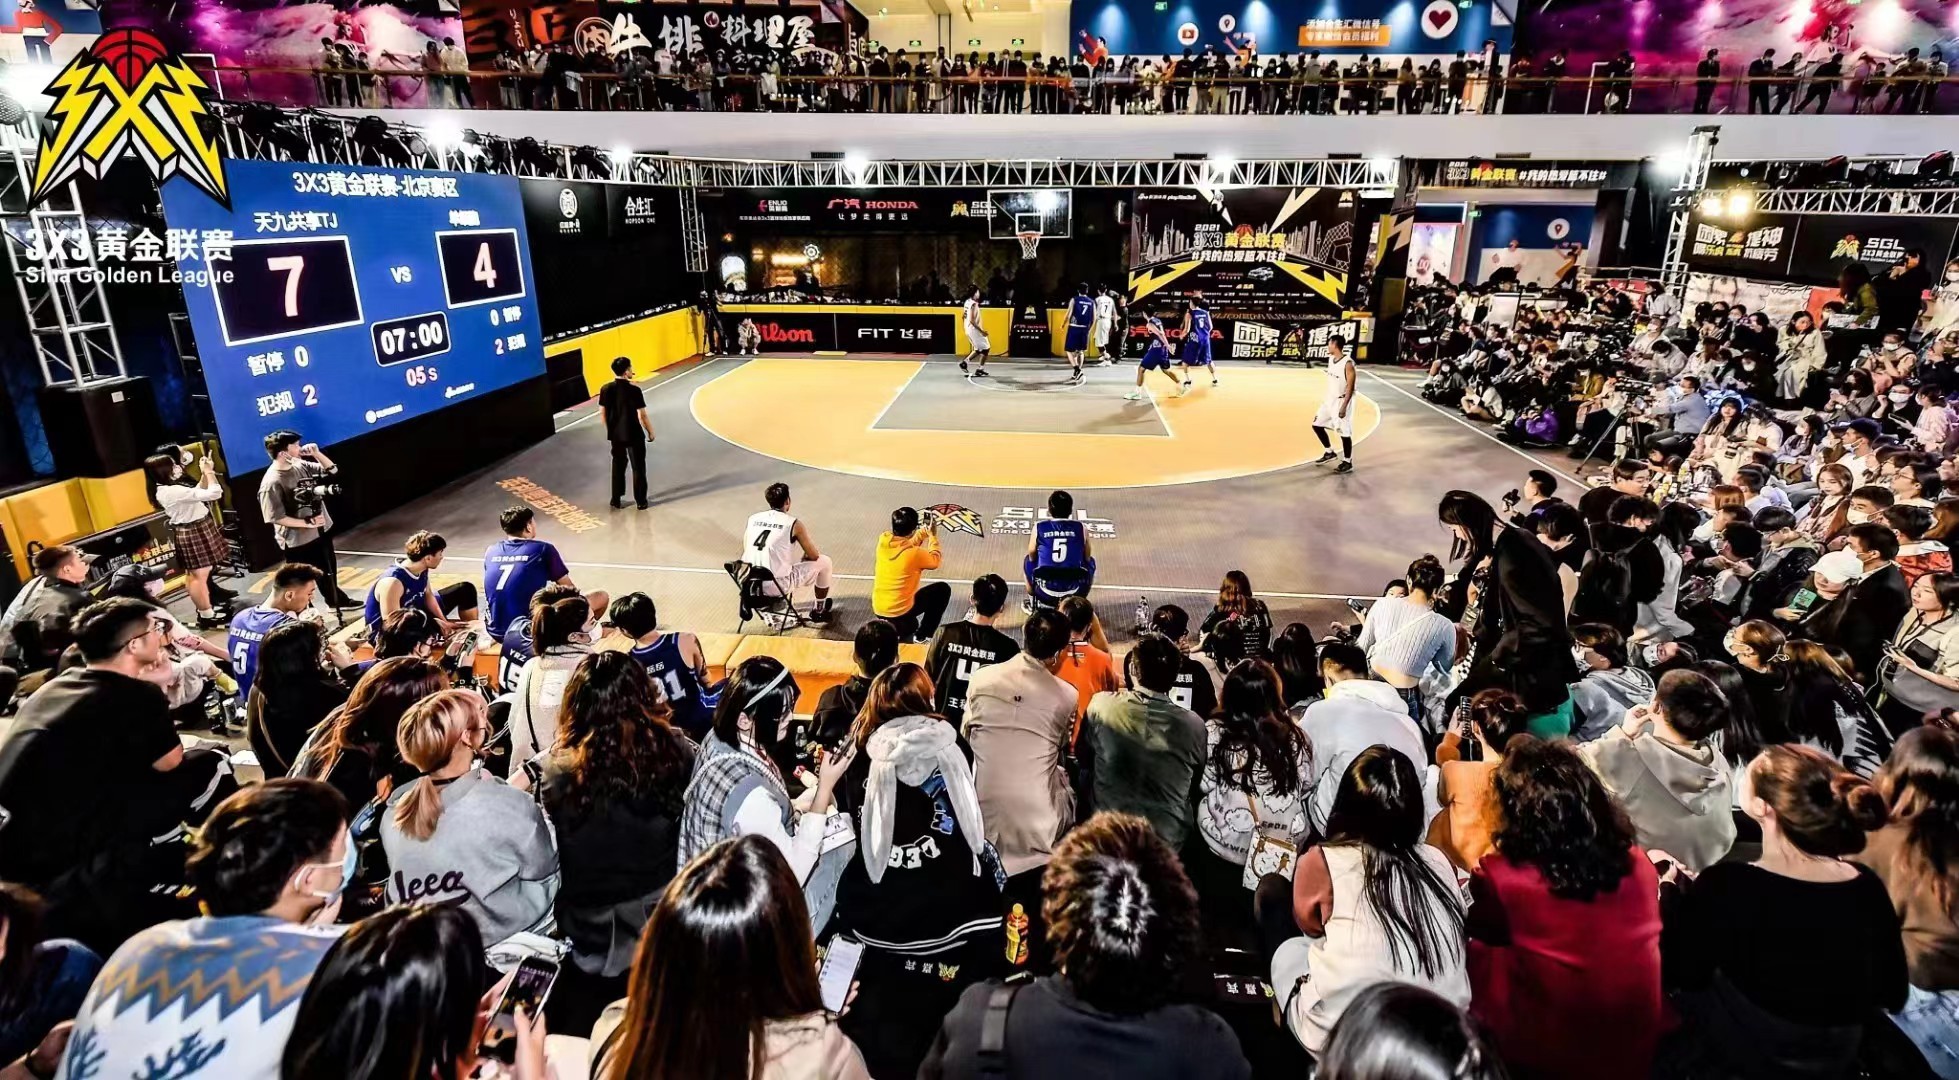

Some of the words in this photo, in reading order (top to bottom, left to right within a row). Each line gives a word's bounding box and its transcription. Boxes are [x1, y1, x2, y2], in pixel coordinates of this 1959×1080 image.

[624, 196, 656, 217] 合生汇
[826, 199, 861, 209] 广汽
[865, 201, 919, 209] HONDA
[1194, 224, 1221, 232] 2021
[1193, 232, 1288, 249] 3X3黄金联赛
[1864, 237, 1906, 250] SGL
[267, 255, 304, 317] 7
[390, 266, 412, 283] VS
[473, 242, 497, 288] 4
[1082, 305, 1089, 315] 7
[380, 321, 443, 355] 07:00
[757, 322, 814, 342] ilson
[857, 328, 893, 338] FIT
[494, 338, 504, 355] 2
[247, 351, 285, 377] 暂停
[294, 346, 309, 367] 0
[256, 390, 295, 417] 犯规
[302, 384, 318, 407] 2
[995, 506, 1113, 522] SL
[753, 530, 771, 551] 4
[1052, 538, 1067, 563] 5
[496, 563, 515, 591] 7
[232, 642, 250, 675] 5
[509, 648, 528, 662] YRZ
[947, 642, 996, 661] 3X3黄金联赛
